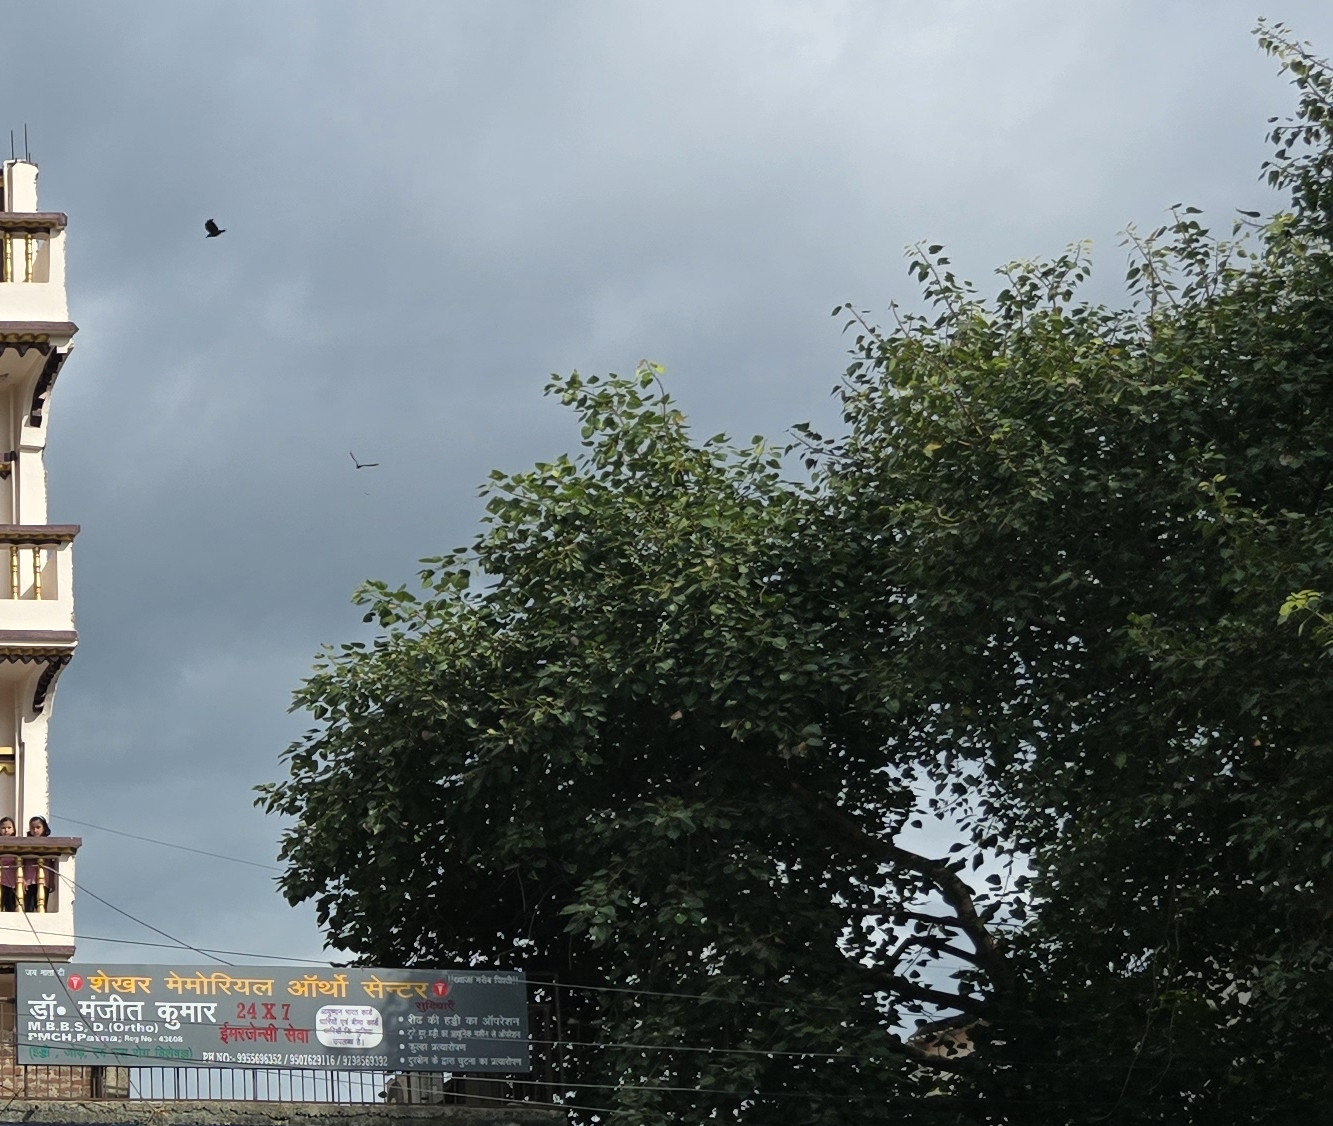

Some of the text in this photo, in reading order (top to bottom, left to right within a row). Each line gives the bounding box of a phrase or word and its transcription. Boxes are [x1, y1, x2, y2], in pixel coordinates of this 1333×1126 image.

[87, 970, 429, 999] शेखर मेमोरियल ऑर्थो सेन्टर
[78, 994, 144, 1021] मंजीत
[155, 1001, 217, 1030] कुमार
[237, 1003, 291, 1020] 24 X 7
[93, 1022, 159, 1033] D.(Ortho)
[285, 1024, 310, 1043] सेवा
[290, 1054, 334, 1065] 9507629116
